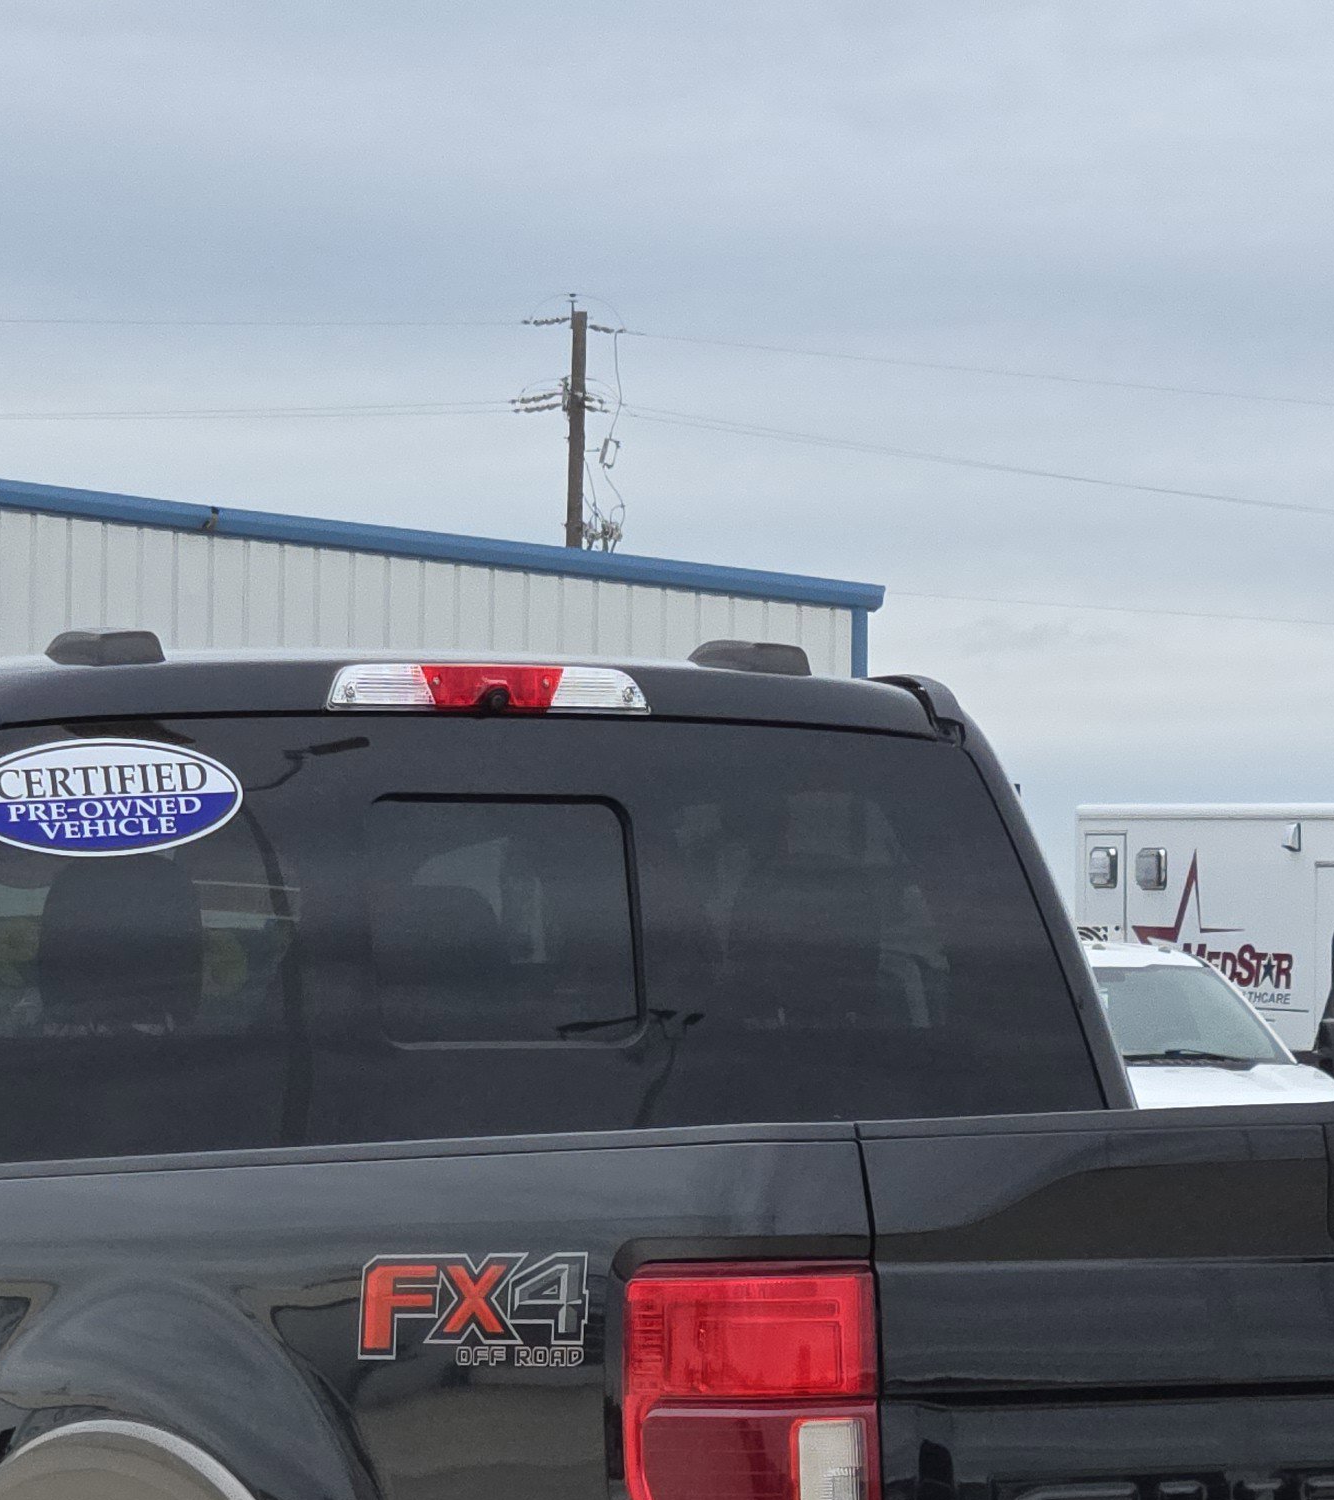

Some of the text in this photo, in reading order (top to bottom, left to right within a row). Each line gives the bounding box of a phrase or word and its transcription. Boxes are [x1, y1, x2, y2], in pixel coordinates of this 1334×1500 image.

[7, 796, 202, 823] PRE-OWNED
[38, 816, 177, 840] VEHICLE
[358, 1252, 589, 1360] FX4
[455, 1346, 585, 1367] OFF ROAD
